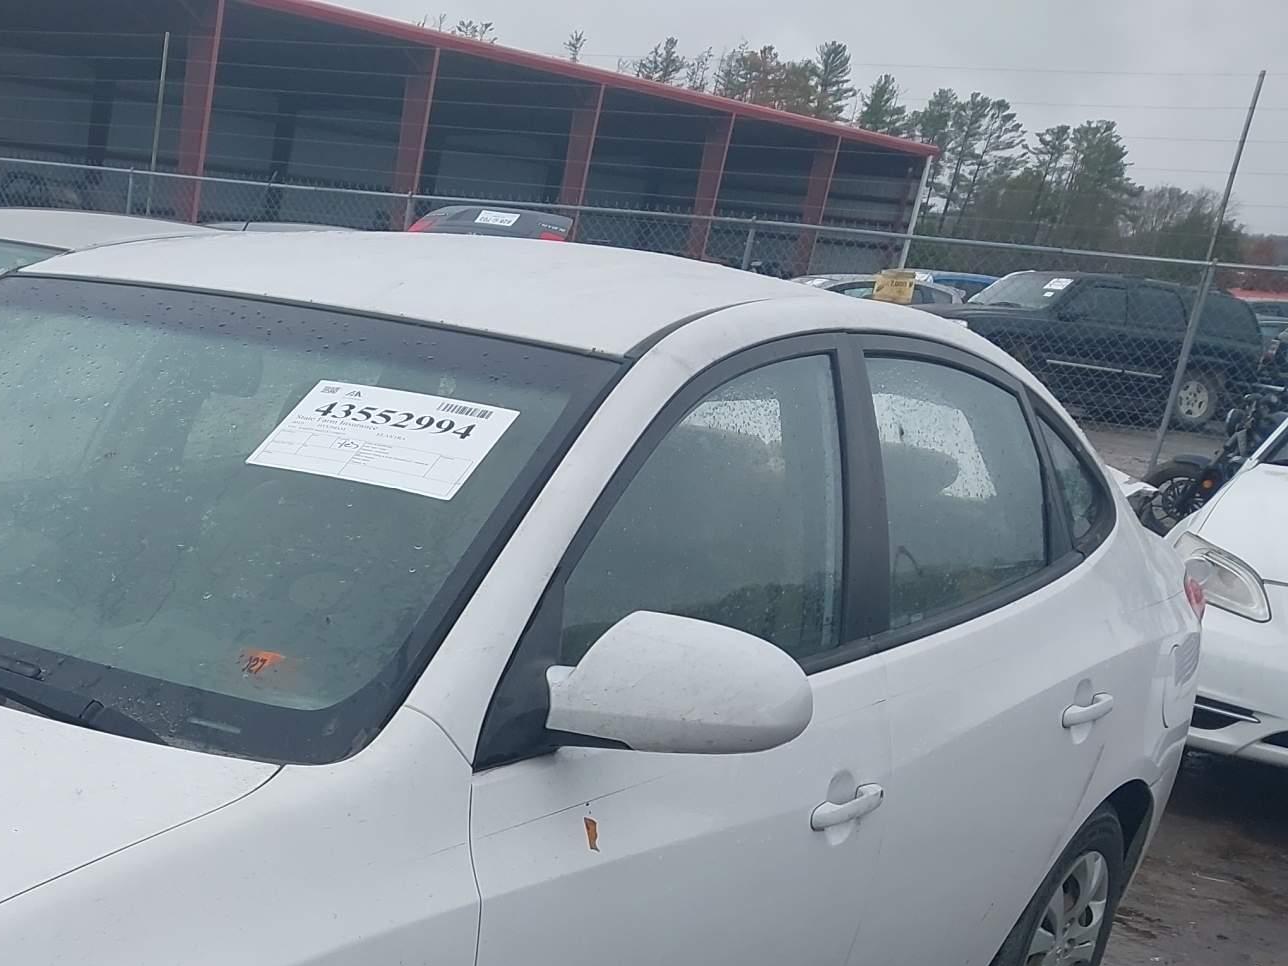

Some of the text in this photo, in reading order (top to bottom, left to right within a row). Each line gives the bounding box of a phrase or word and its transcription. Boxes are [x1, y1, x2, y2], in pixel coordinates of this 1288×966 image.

[314, 401, 476, 440] 43552994
[316, 416, 338, 425] Farm
[339, 419, 379, 431] Insurance
